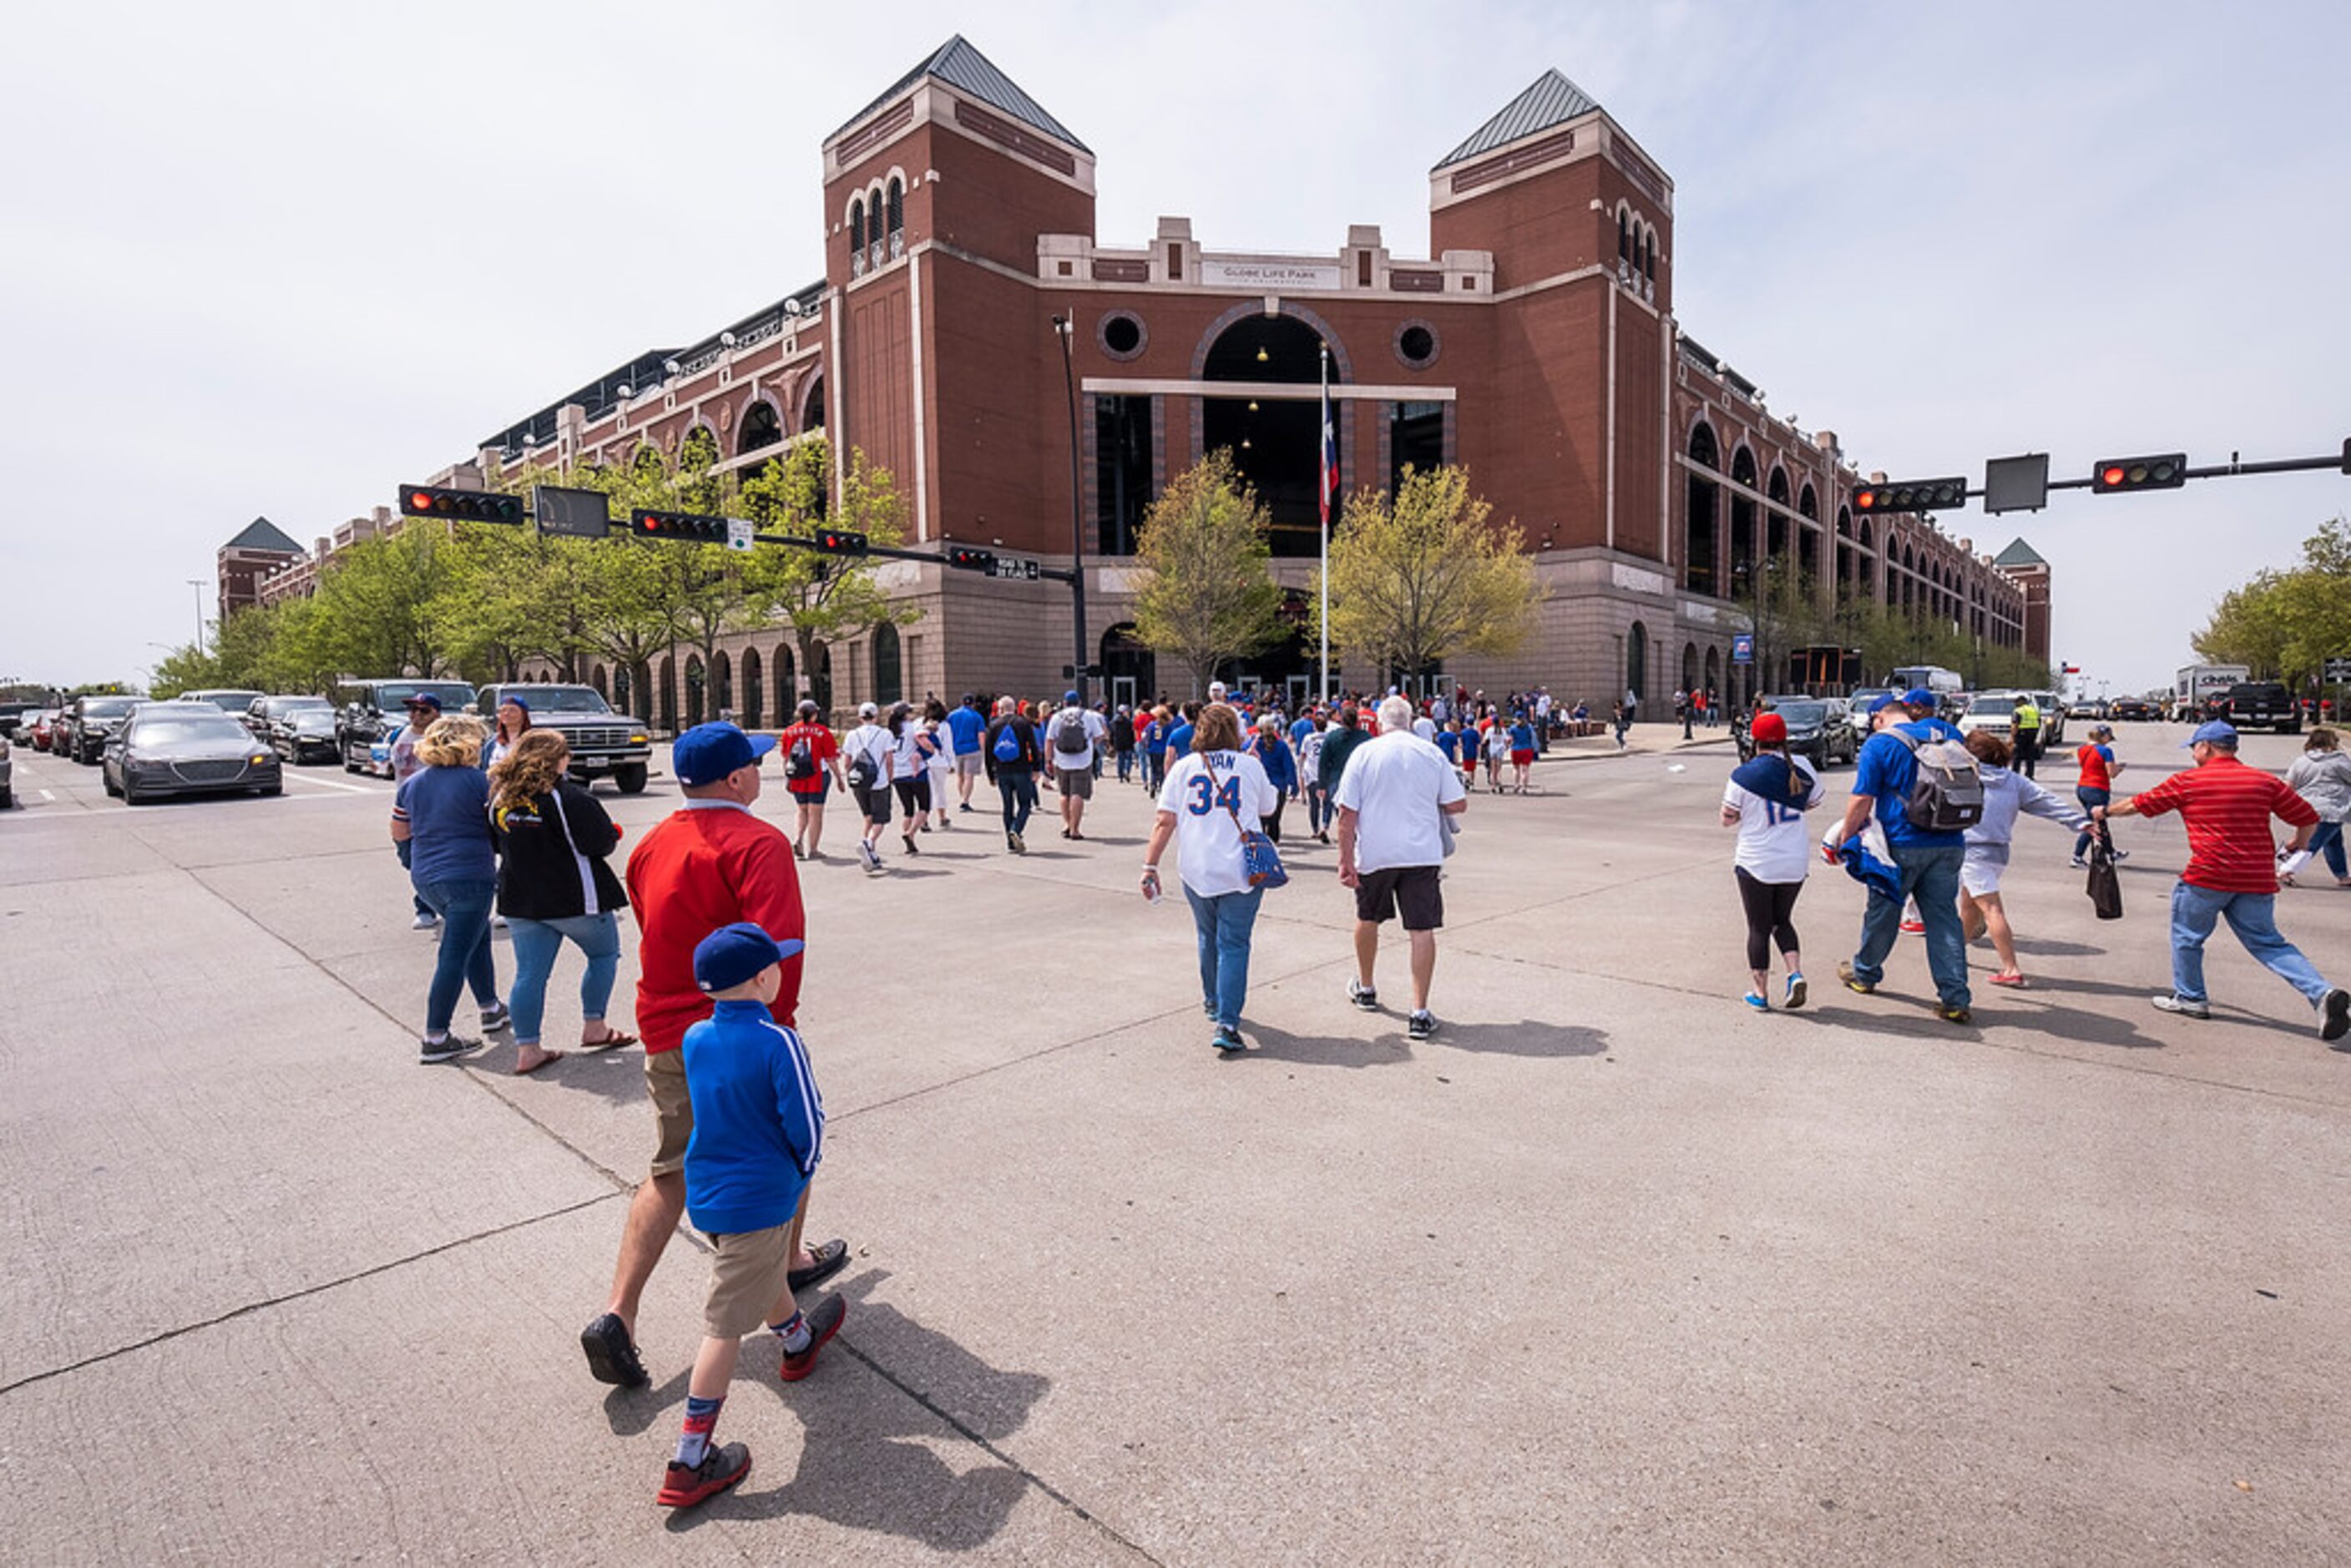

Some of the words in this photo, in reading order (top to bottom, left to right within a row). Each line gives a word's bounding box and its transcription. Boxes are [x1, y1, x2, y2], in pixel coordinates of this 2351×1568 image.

[1262, 268, 1286, 278] LIFE
[1288, 269, 1316, 279] PARK
[1188, 773, 1241, 817] 34
